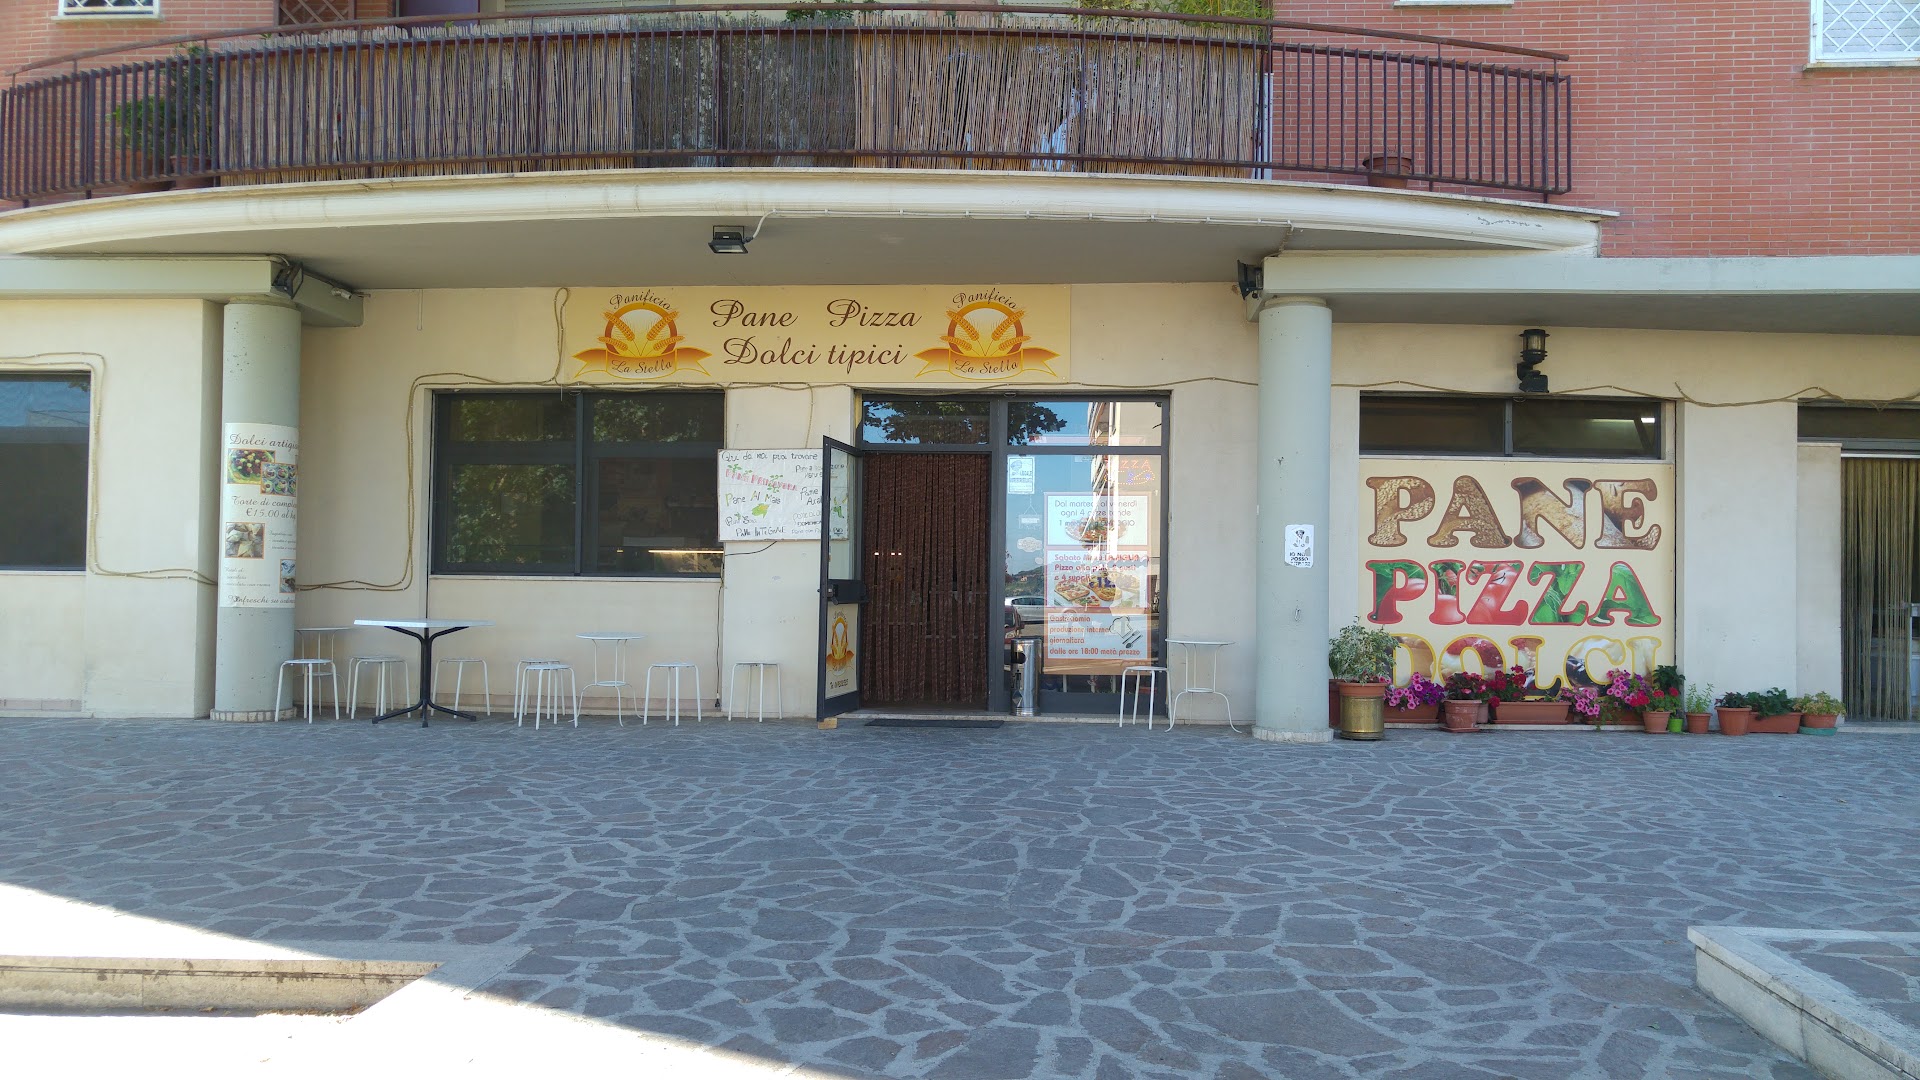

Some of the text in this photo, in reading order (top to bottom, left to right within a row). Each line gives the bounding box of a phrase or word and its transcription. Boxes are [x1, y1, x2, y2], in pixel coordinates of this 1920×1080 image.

[609, 289, 672, 310] Panificio
[952, 287, 1017, 310] Panificio
[710, 299, 922, 327] Pane Pizza
[723, 336, 908, 375] Dolci tipici
[611, 358, 673, 374] La Stella
[954, 358, 1019, 374] La Stella
[230, 433, 267, 446] Dolci
[721, 451, 739, 462] Qui
[232, 496, 258, 506] Torte
[260, 498, 270, 506] di
[1055, 500, 1067, 508] Dal
[1060, 510, 1078, 519] ogni
[1366, 475, 1662, 551] PANE
[1055, 553, 1081, 561] Sabato
[1365, 559, 1662, 626] PIZZA
[1050, 626, 1110, 634] produzione interna
[1050, 637, 1085, 645] giornaliera
[1050, 647, 1067, 655] dalle
[1081, 647, 1099, 656] 18:00
[1101, 647, 1117, 656] metà
[1119, 649, 1141, 657] prezzo
